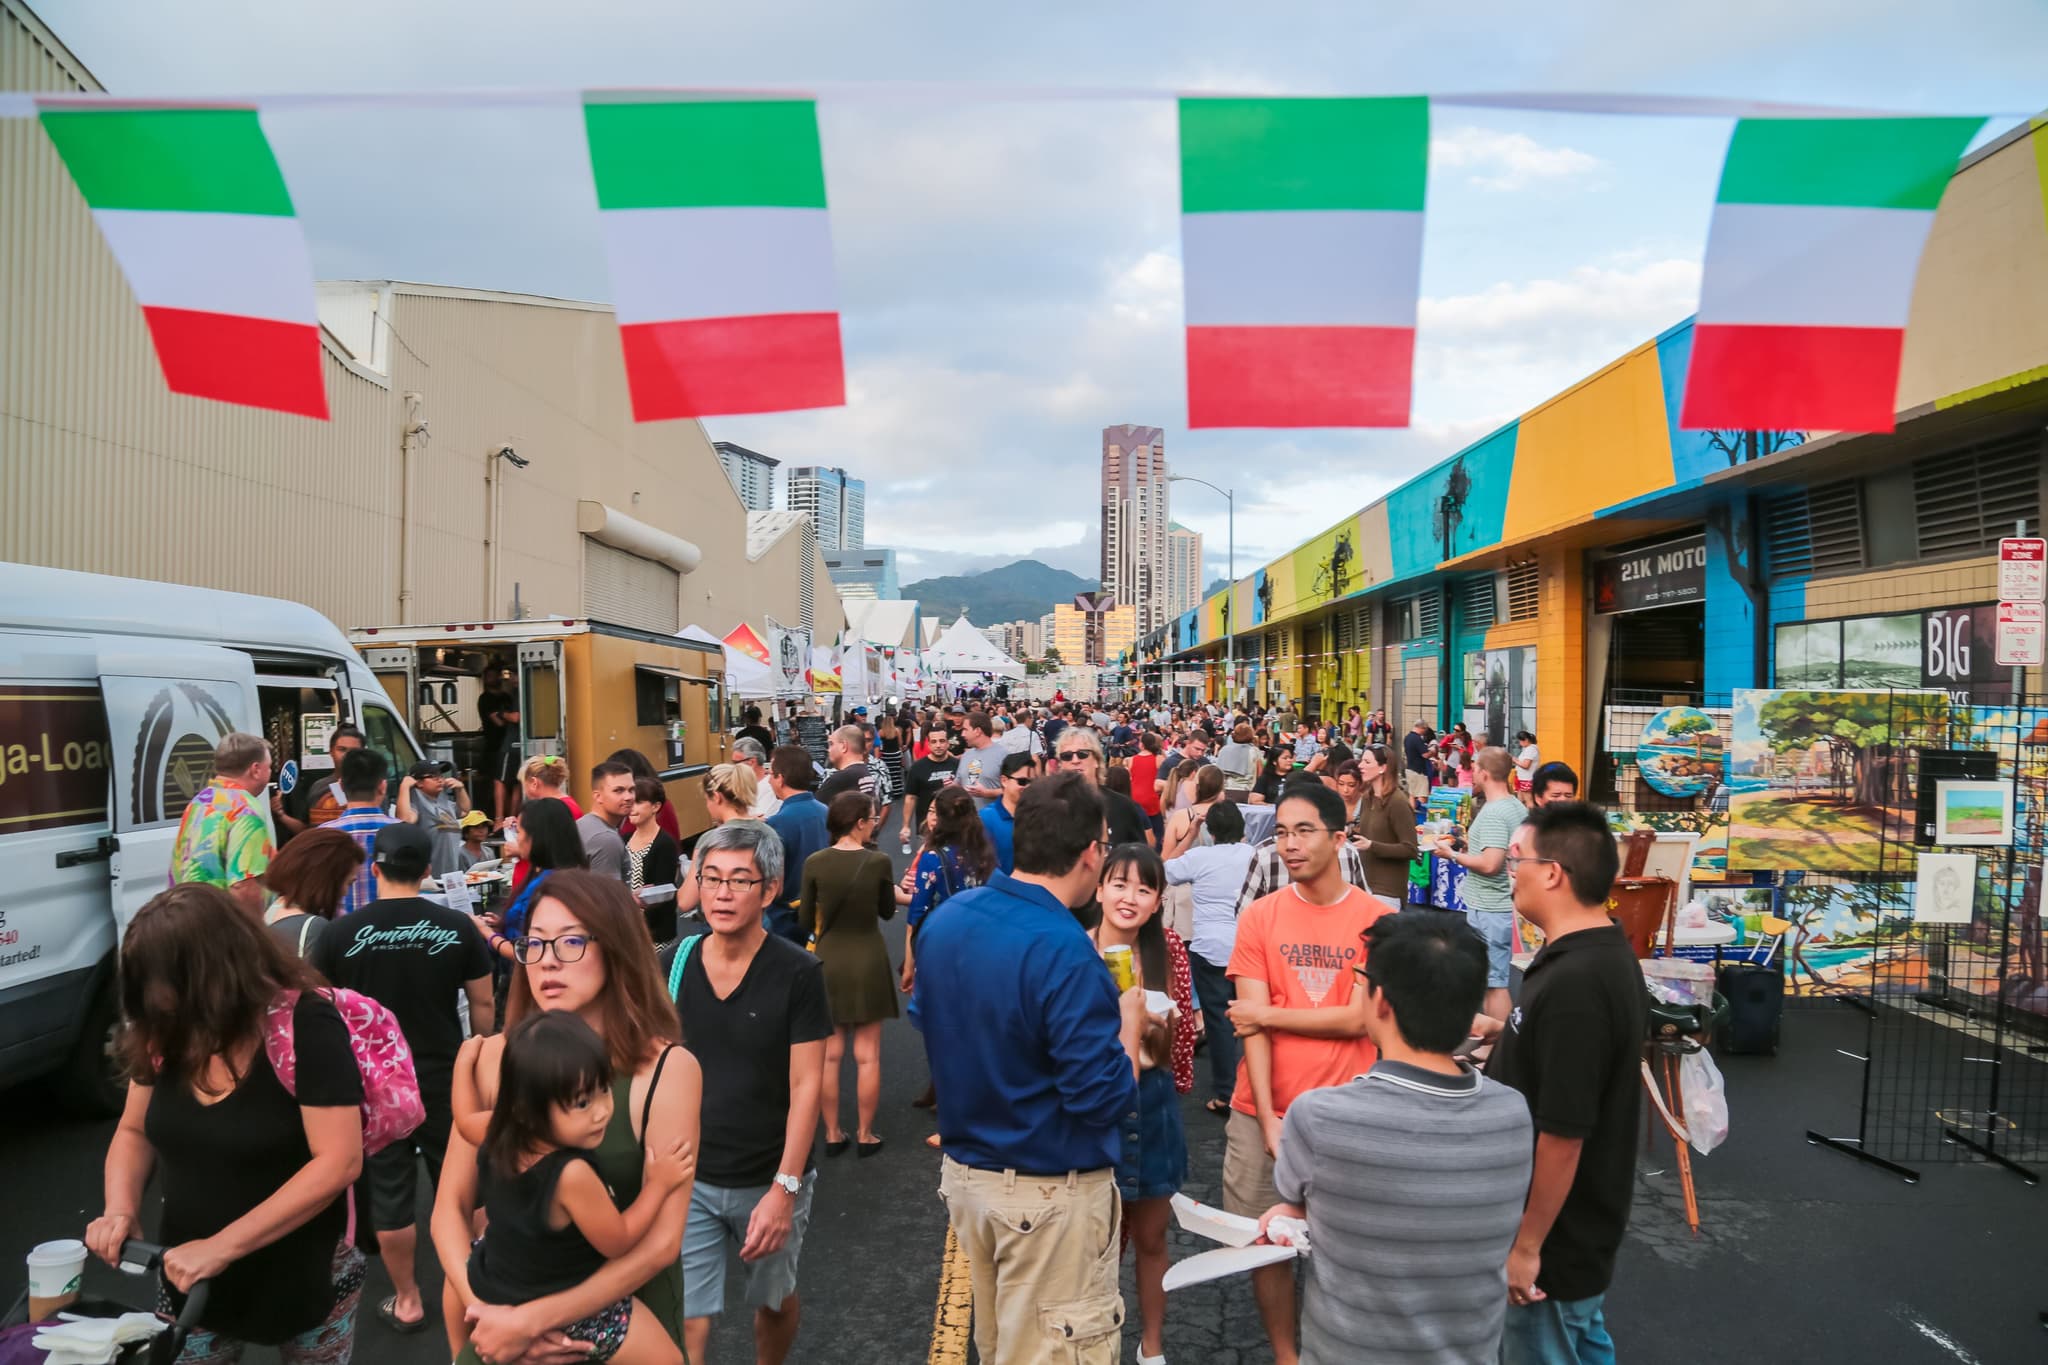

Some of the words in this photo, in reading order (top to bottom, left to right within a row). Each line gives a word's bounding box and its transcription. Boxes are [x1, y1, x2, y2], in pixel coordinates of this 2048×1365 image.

[2011, 551, 2033, 559] ZONE
[1621, 557, 1652, 581] 21K
[1928, 615, 1970, 679] BIG
[344, 919, 463, 958] Something
[1279, 943, 1356, 960] CABRILLO
[1287, 956, 1344, 969] FESTIVAL
